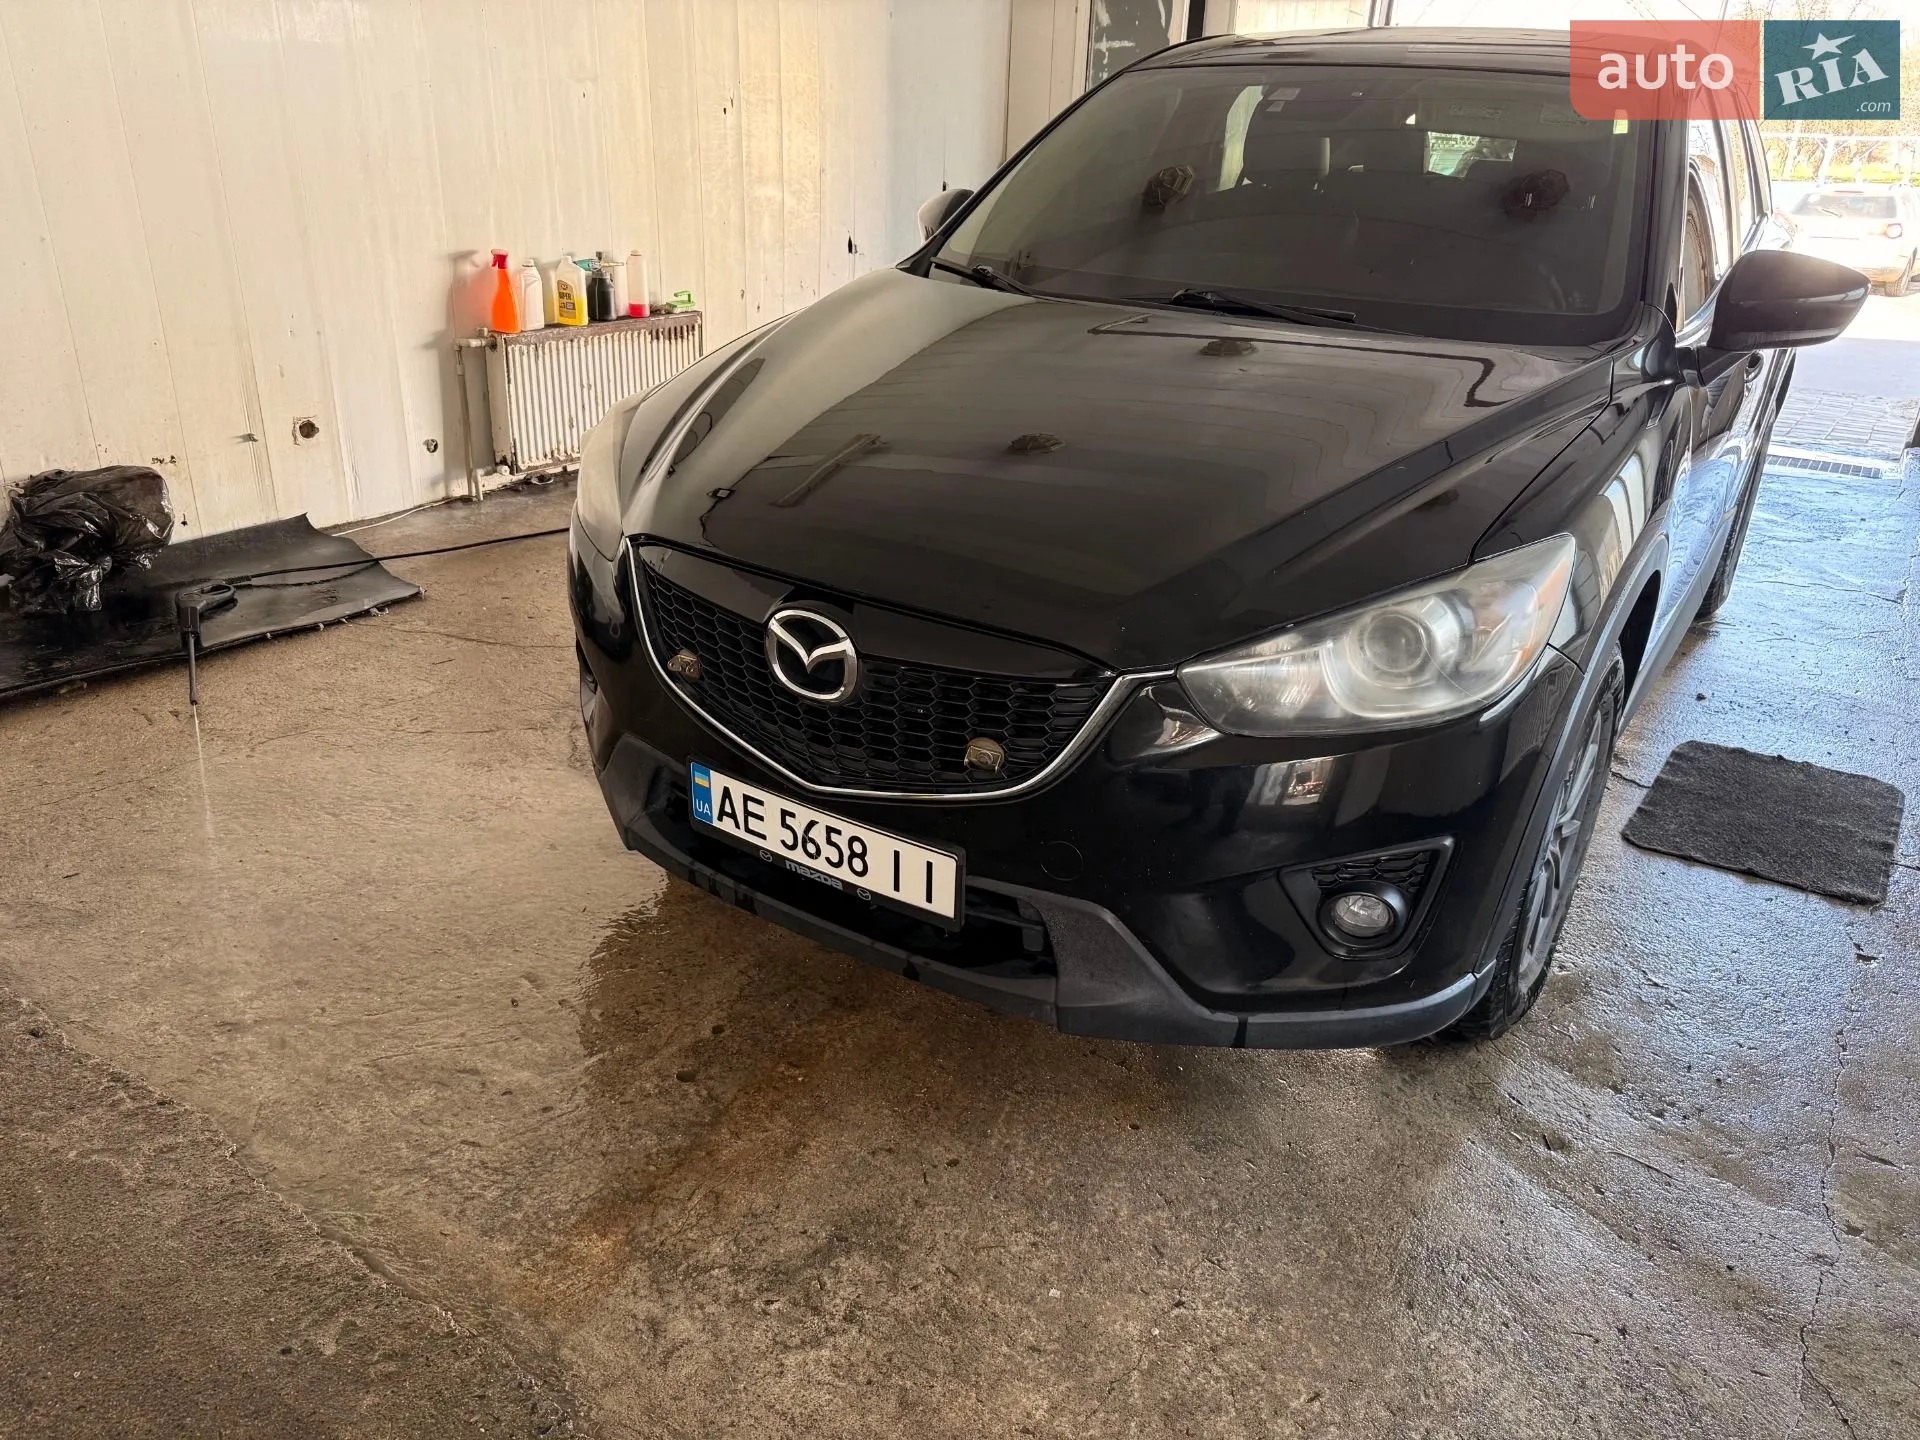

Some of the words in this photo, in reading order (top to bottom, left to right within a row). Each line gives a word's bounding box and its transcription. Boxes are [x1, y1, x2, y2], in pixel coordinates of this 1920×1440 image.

[696, 798, 711, 816] UA
[717, 785, 767, 841] AE
[780, 807, 869, 878] 5658
[784, 859, 843, 890] mazda
